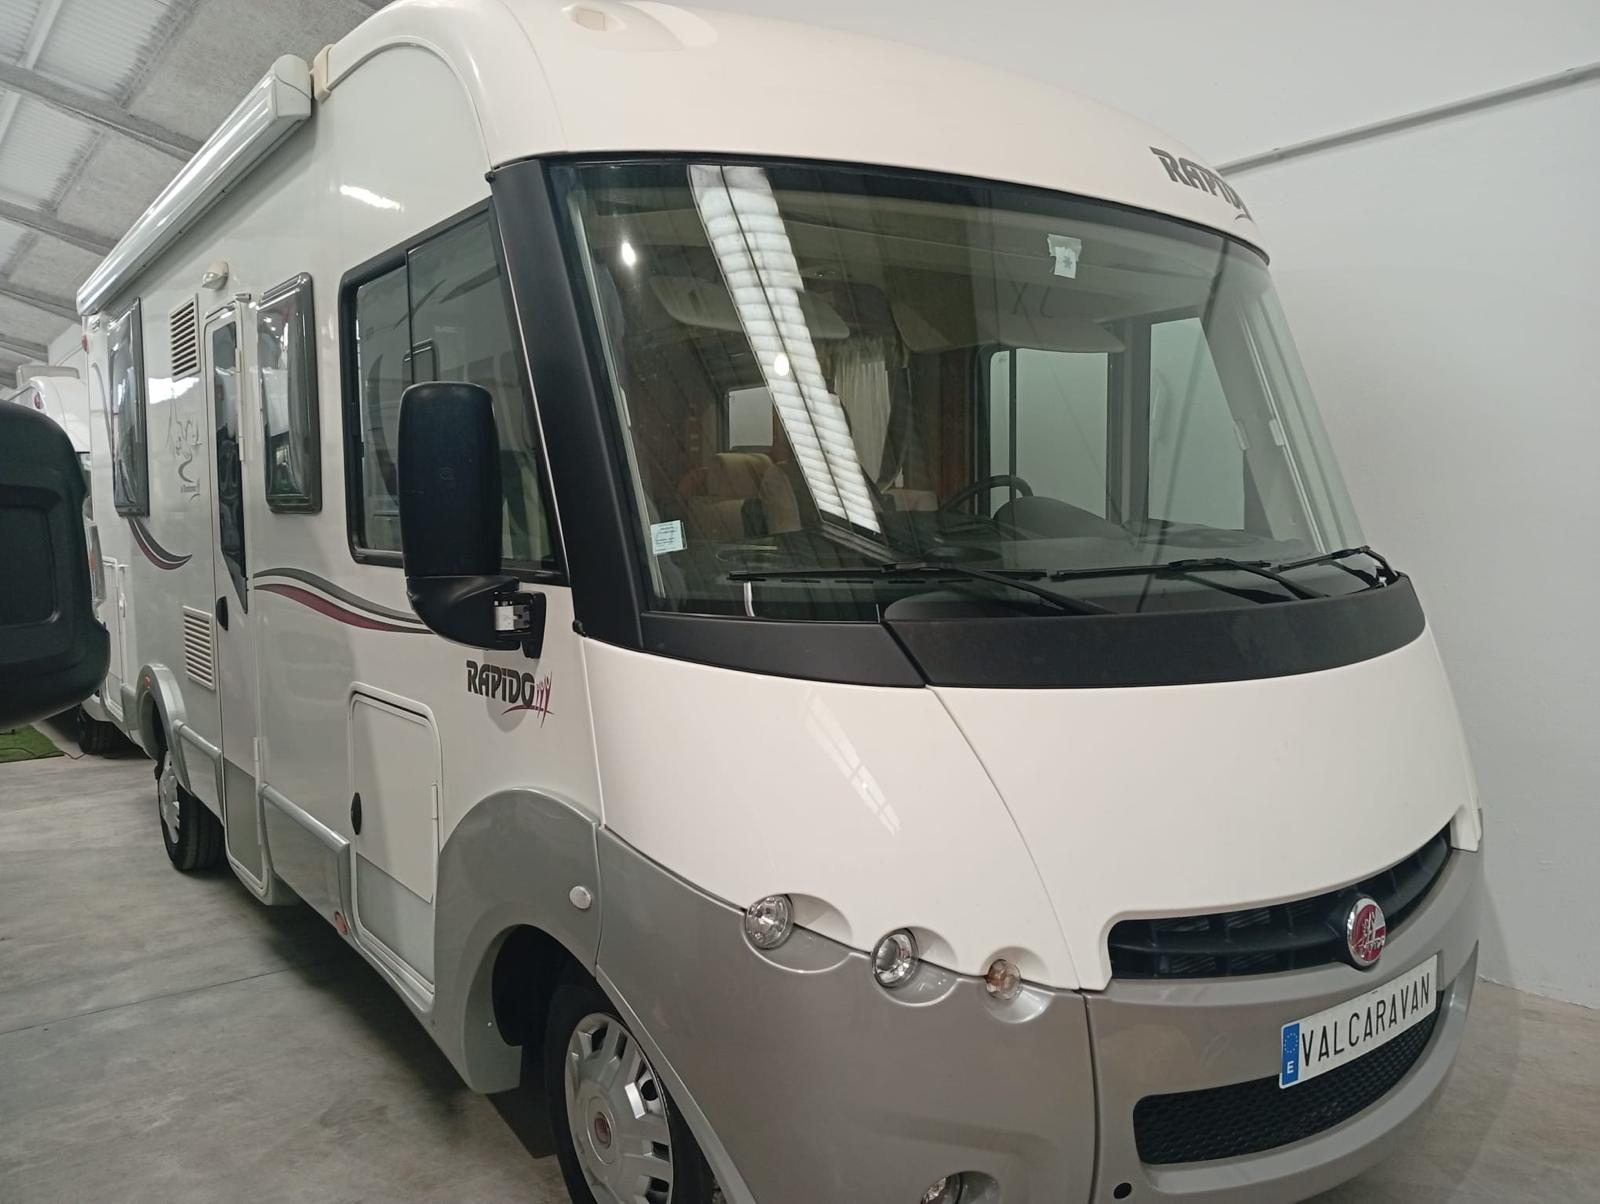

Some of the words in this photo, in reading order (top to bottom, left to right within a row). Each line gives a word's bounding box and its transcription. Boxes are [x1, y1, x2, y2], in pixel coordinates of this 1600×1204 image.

[1149, 146, 1249, 212] RAPID
[466, 660, 535, 706] RAPIDO
[1301, 972, 1430, 1067] VALCARAVAN
[1286, 1060, 1294, 1074] E
